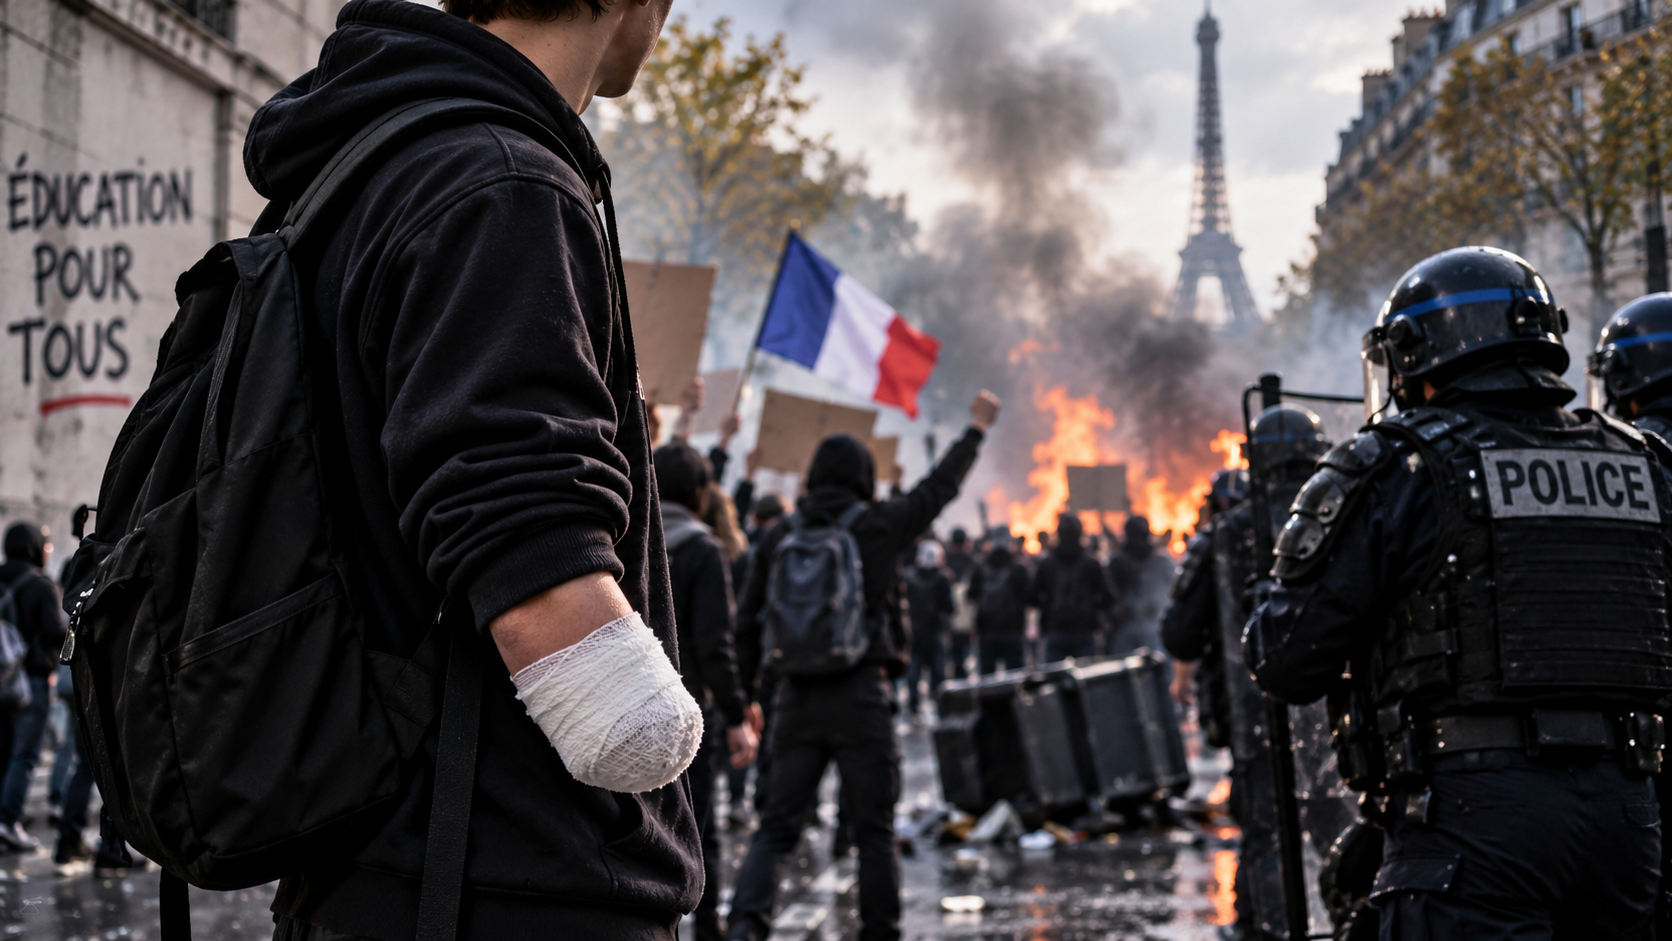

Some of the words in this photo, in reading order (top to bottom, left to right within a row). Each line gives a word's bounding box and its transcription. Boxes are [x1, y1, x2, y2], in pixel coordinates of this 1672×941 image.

[34, 243, 139, 306] POUR
[8, 317, 130, 385] TOUS
[1496, 459, 1650, 510] POLICE
